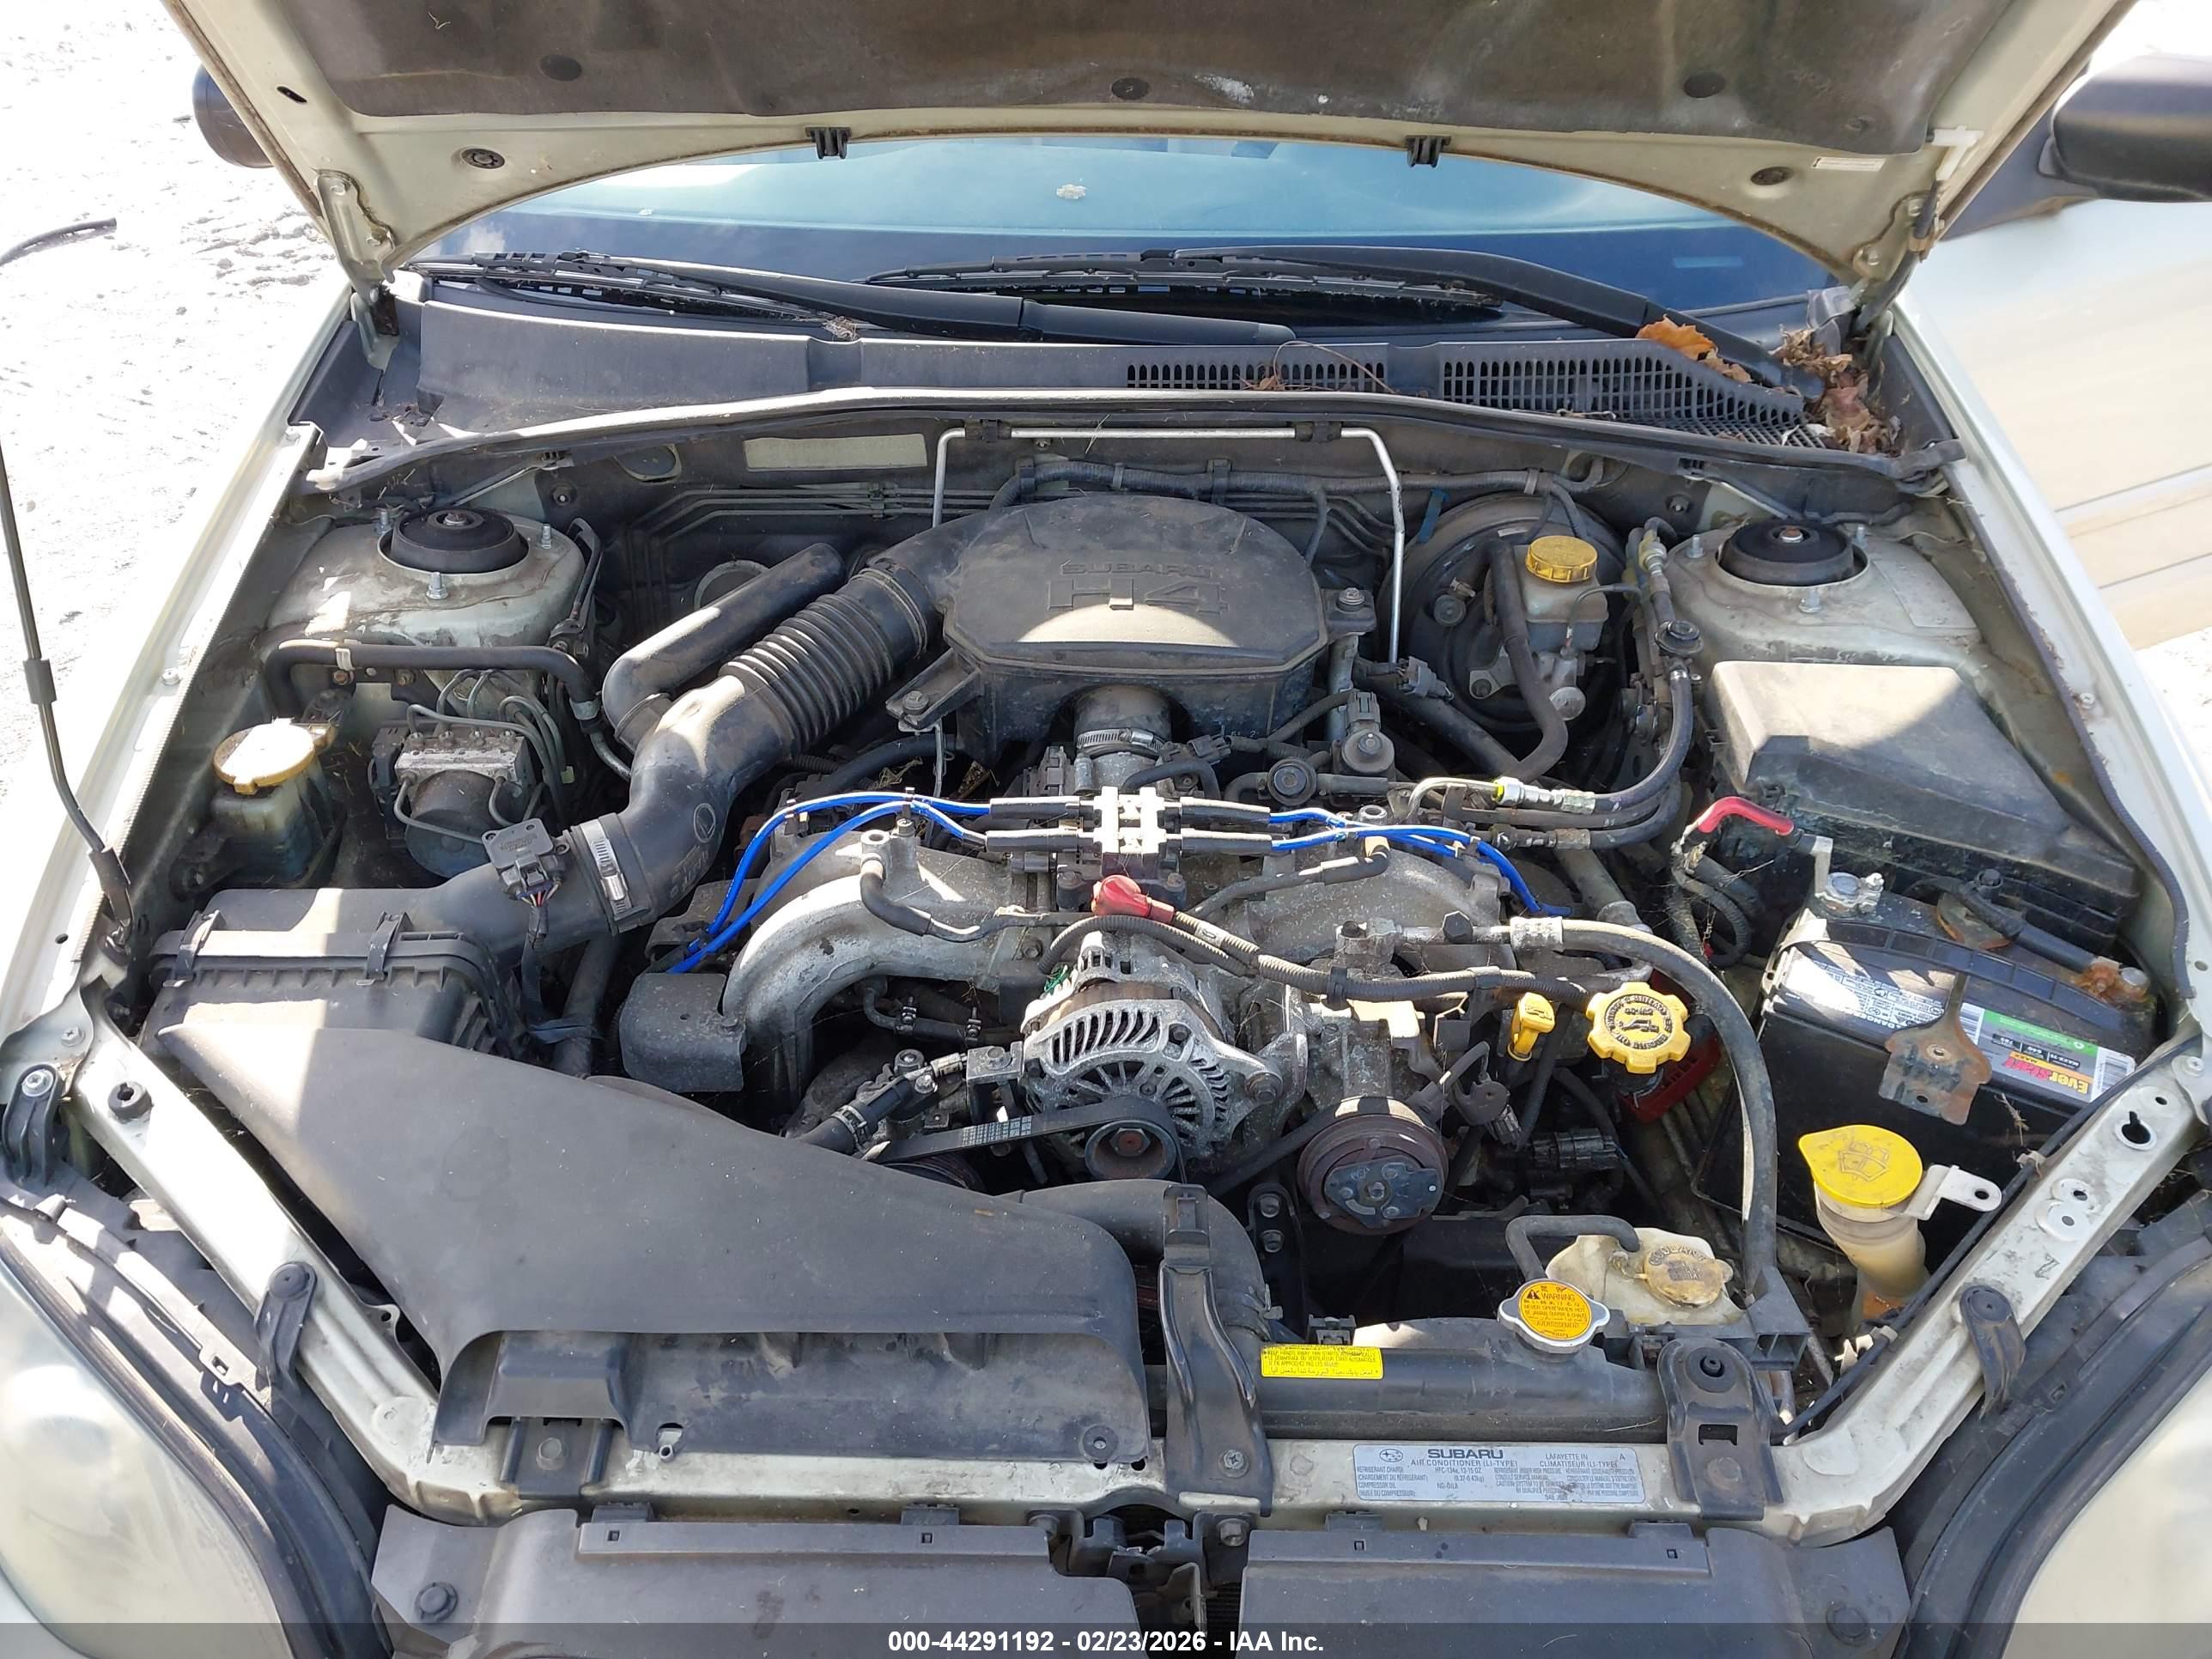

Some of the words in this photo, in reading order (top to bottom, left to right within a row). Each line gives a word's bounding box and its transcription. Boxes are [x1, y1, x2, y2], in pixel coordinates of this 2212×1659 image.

[1060, 563, 1212, 577] SUBARU
[2002, 1055, 2089, 1095] EverStart
[1540, 1292, 1576, 1301] WARNING
[1428, 1449, 1504, 1459] SUBARU
